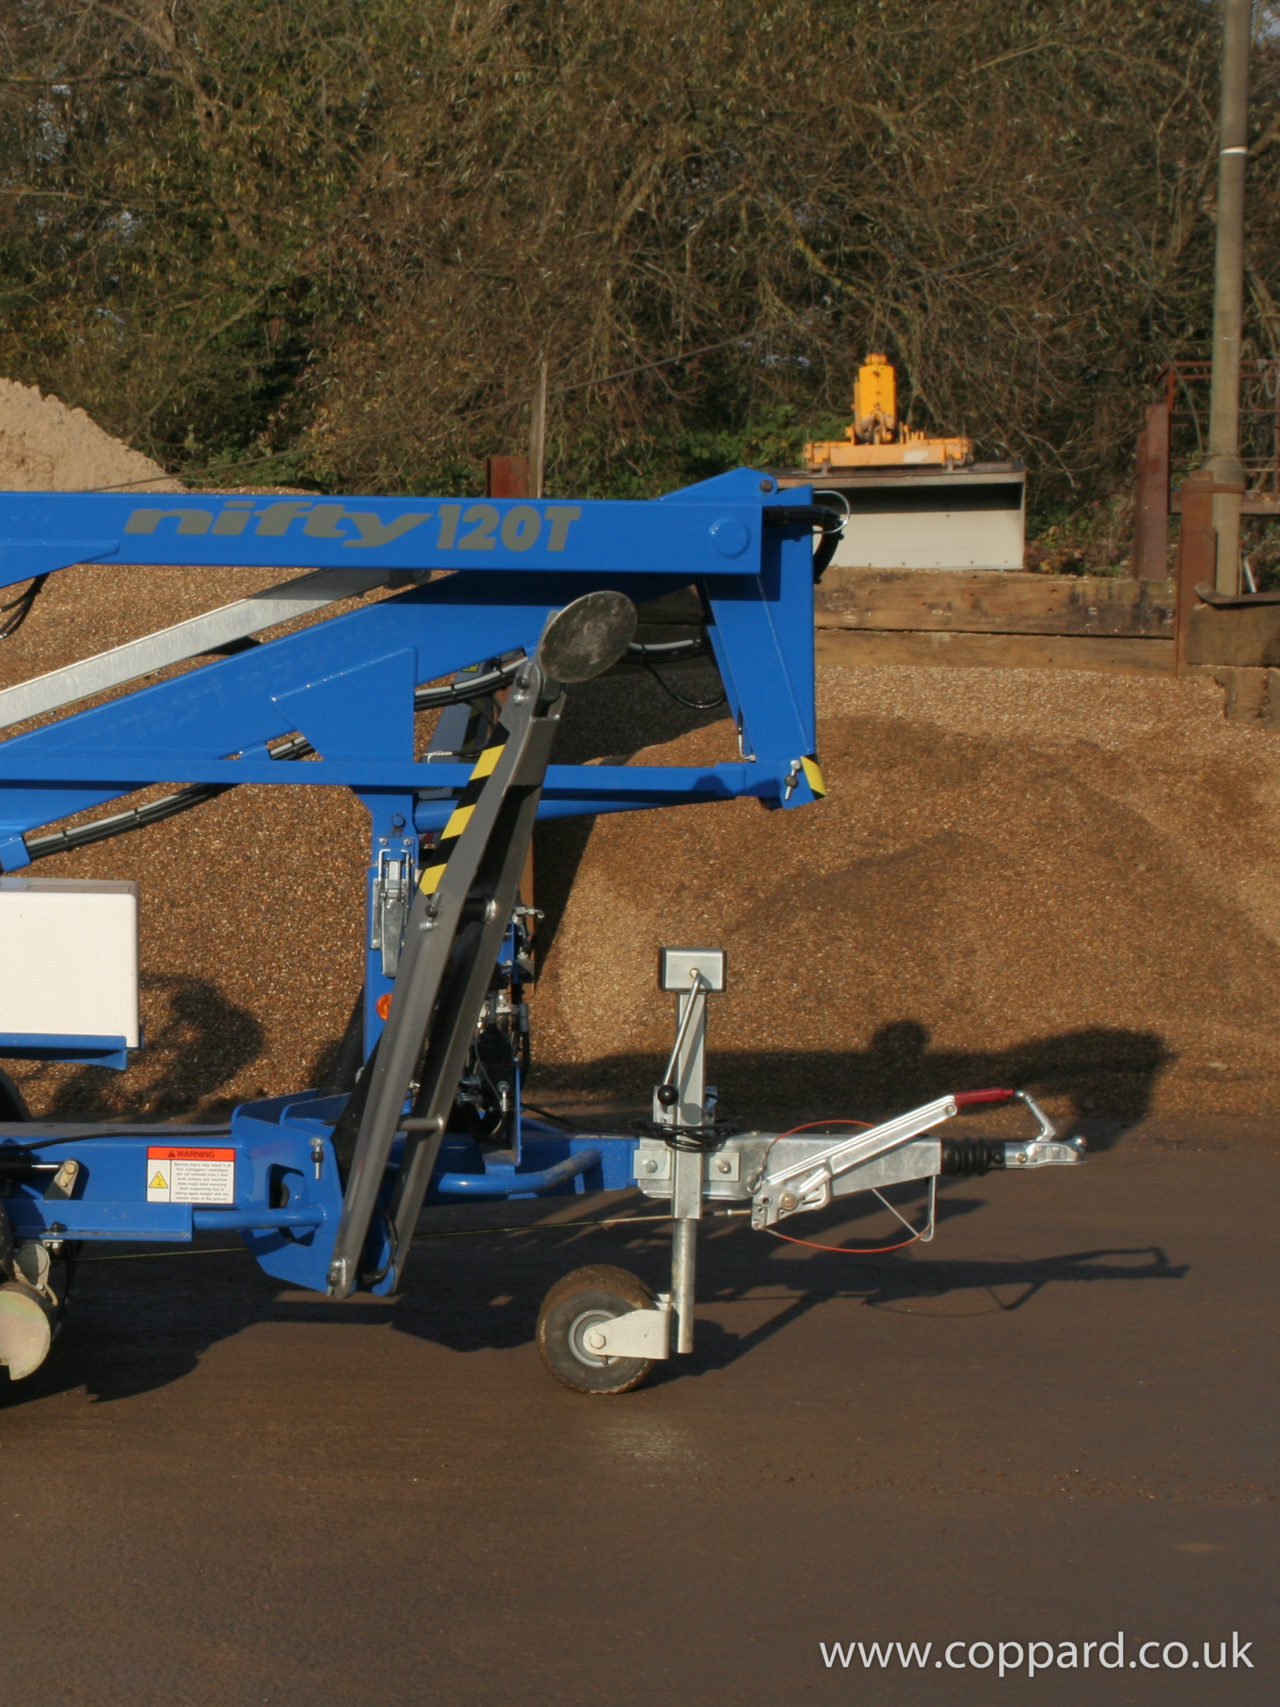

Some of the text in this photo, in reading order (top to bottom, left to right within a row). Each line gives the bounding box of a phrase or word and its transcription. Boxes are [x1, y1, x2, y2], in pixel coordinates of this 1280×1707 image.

[123, 500, 582, 552] nifty 120T
[176, 1150, 216, 1158] WARNING
